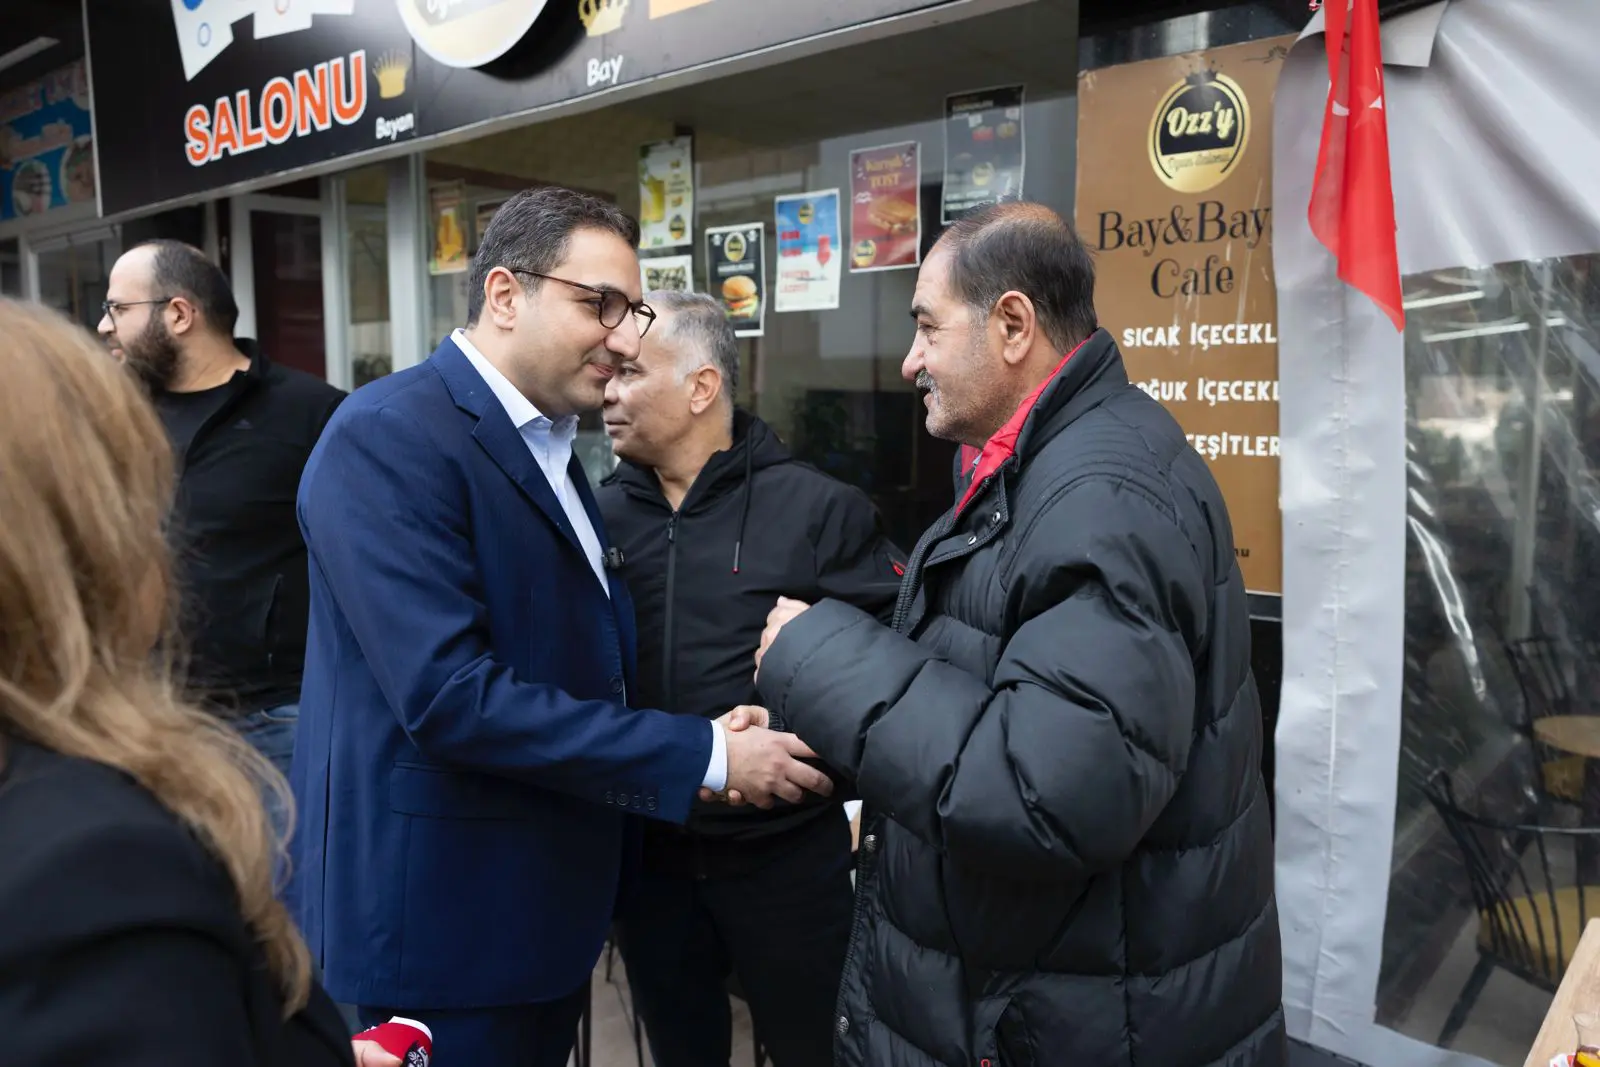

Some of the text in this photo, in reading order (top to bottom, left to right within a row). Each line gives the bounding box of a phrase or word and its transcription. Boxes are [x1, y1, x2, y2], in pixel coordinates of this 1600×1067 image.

[587, 55, 623, 87] Bay
[184, 49, 367, 167] SALONU
[1166, 101, 1235, 139] Ozz'y
[376, 113, 414, 141] Bayan
[1097, 200, 1272, 257] Bay&Bay
[1151, 254, 1234, 299] Cafe
[1122, 326, 1181, 348] SICAK
[1129, 378, 1188, 401] OĞUK
